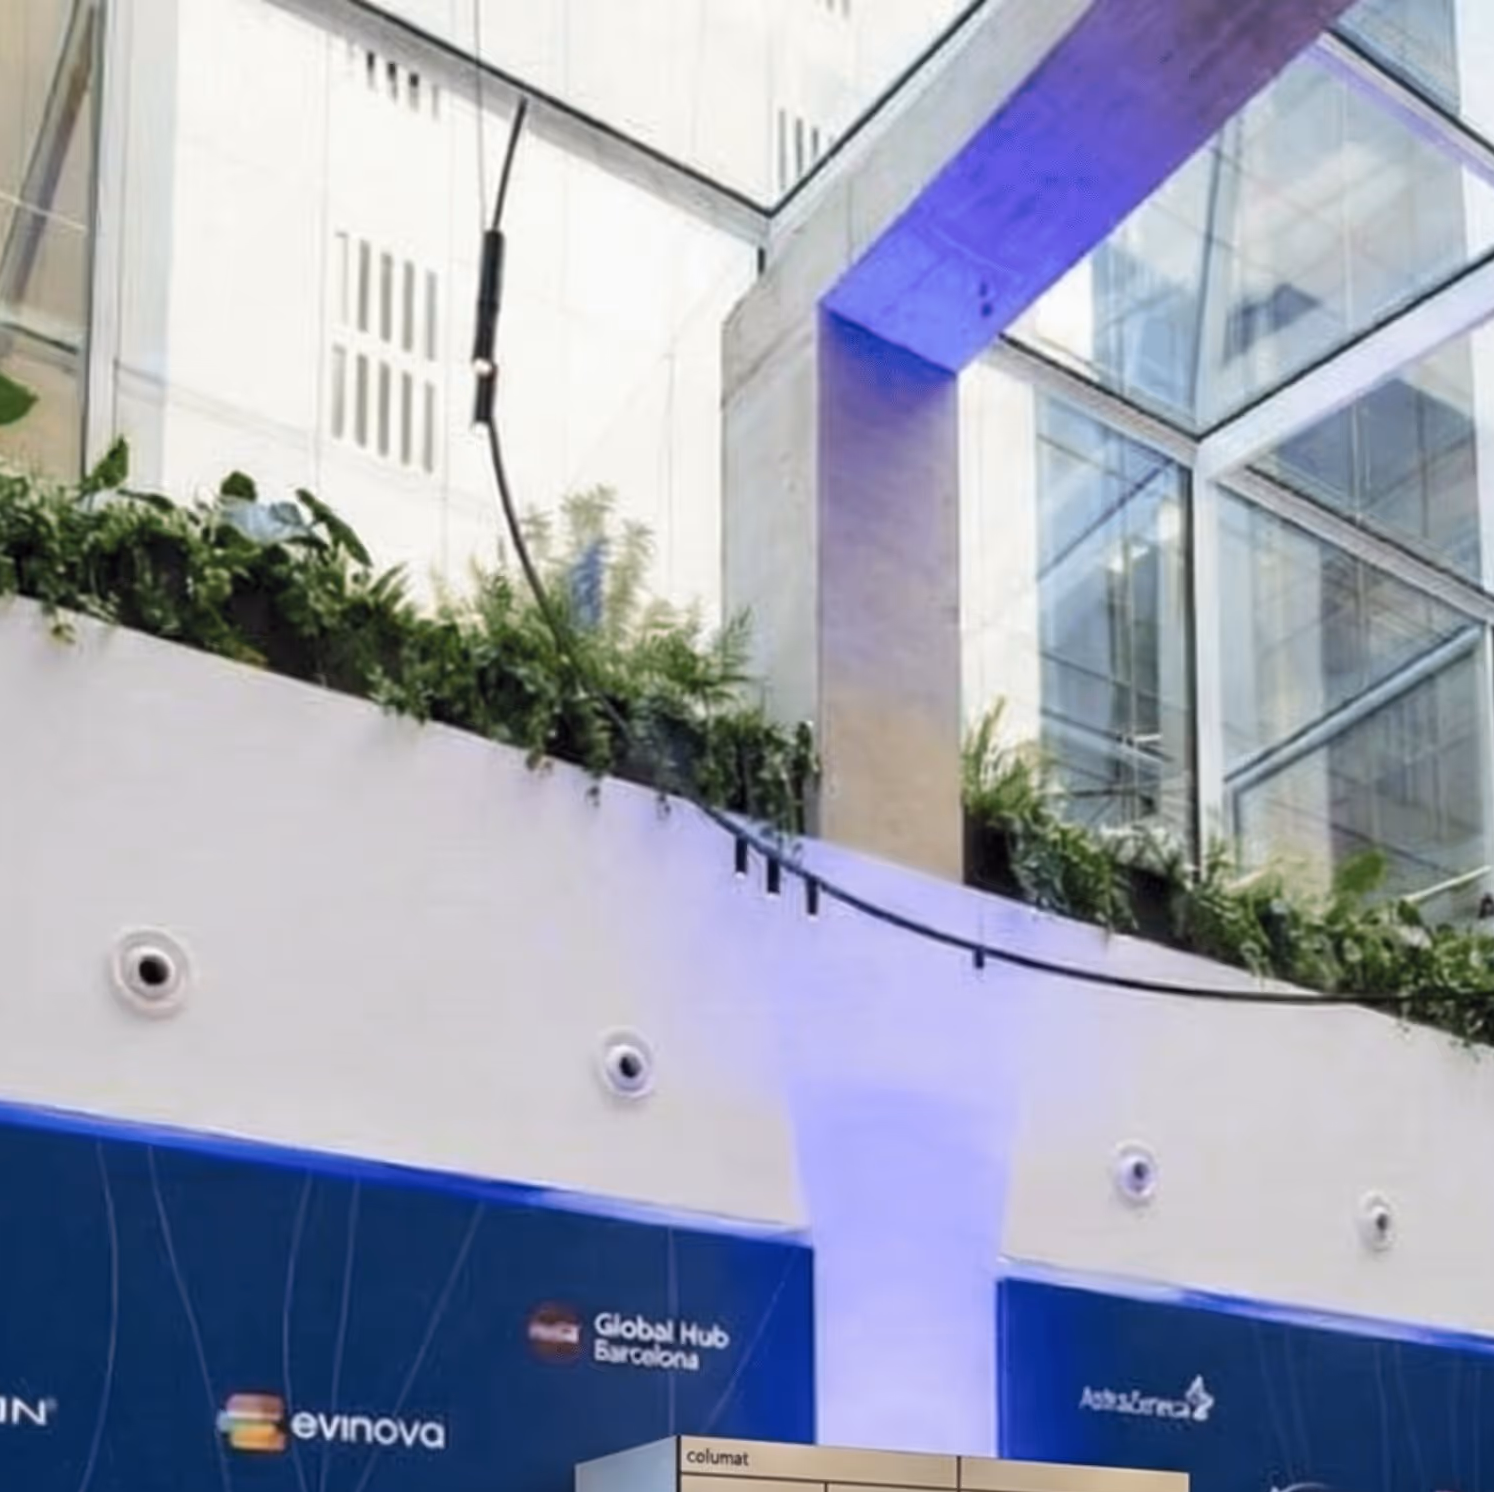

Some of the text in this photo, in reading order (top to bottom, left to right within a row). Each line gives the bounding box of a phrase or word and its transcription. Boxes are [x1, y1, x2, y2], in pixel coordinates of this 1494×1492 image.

[594, 1312, 675, 1343] Global
[679, 1321, 730, 1349] Hub
[594, 1339, 700, 1370] Barcelona
[291, 1411, 446, 1449] evinova
[686, 1448, 750, 1466] columat
